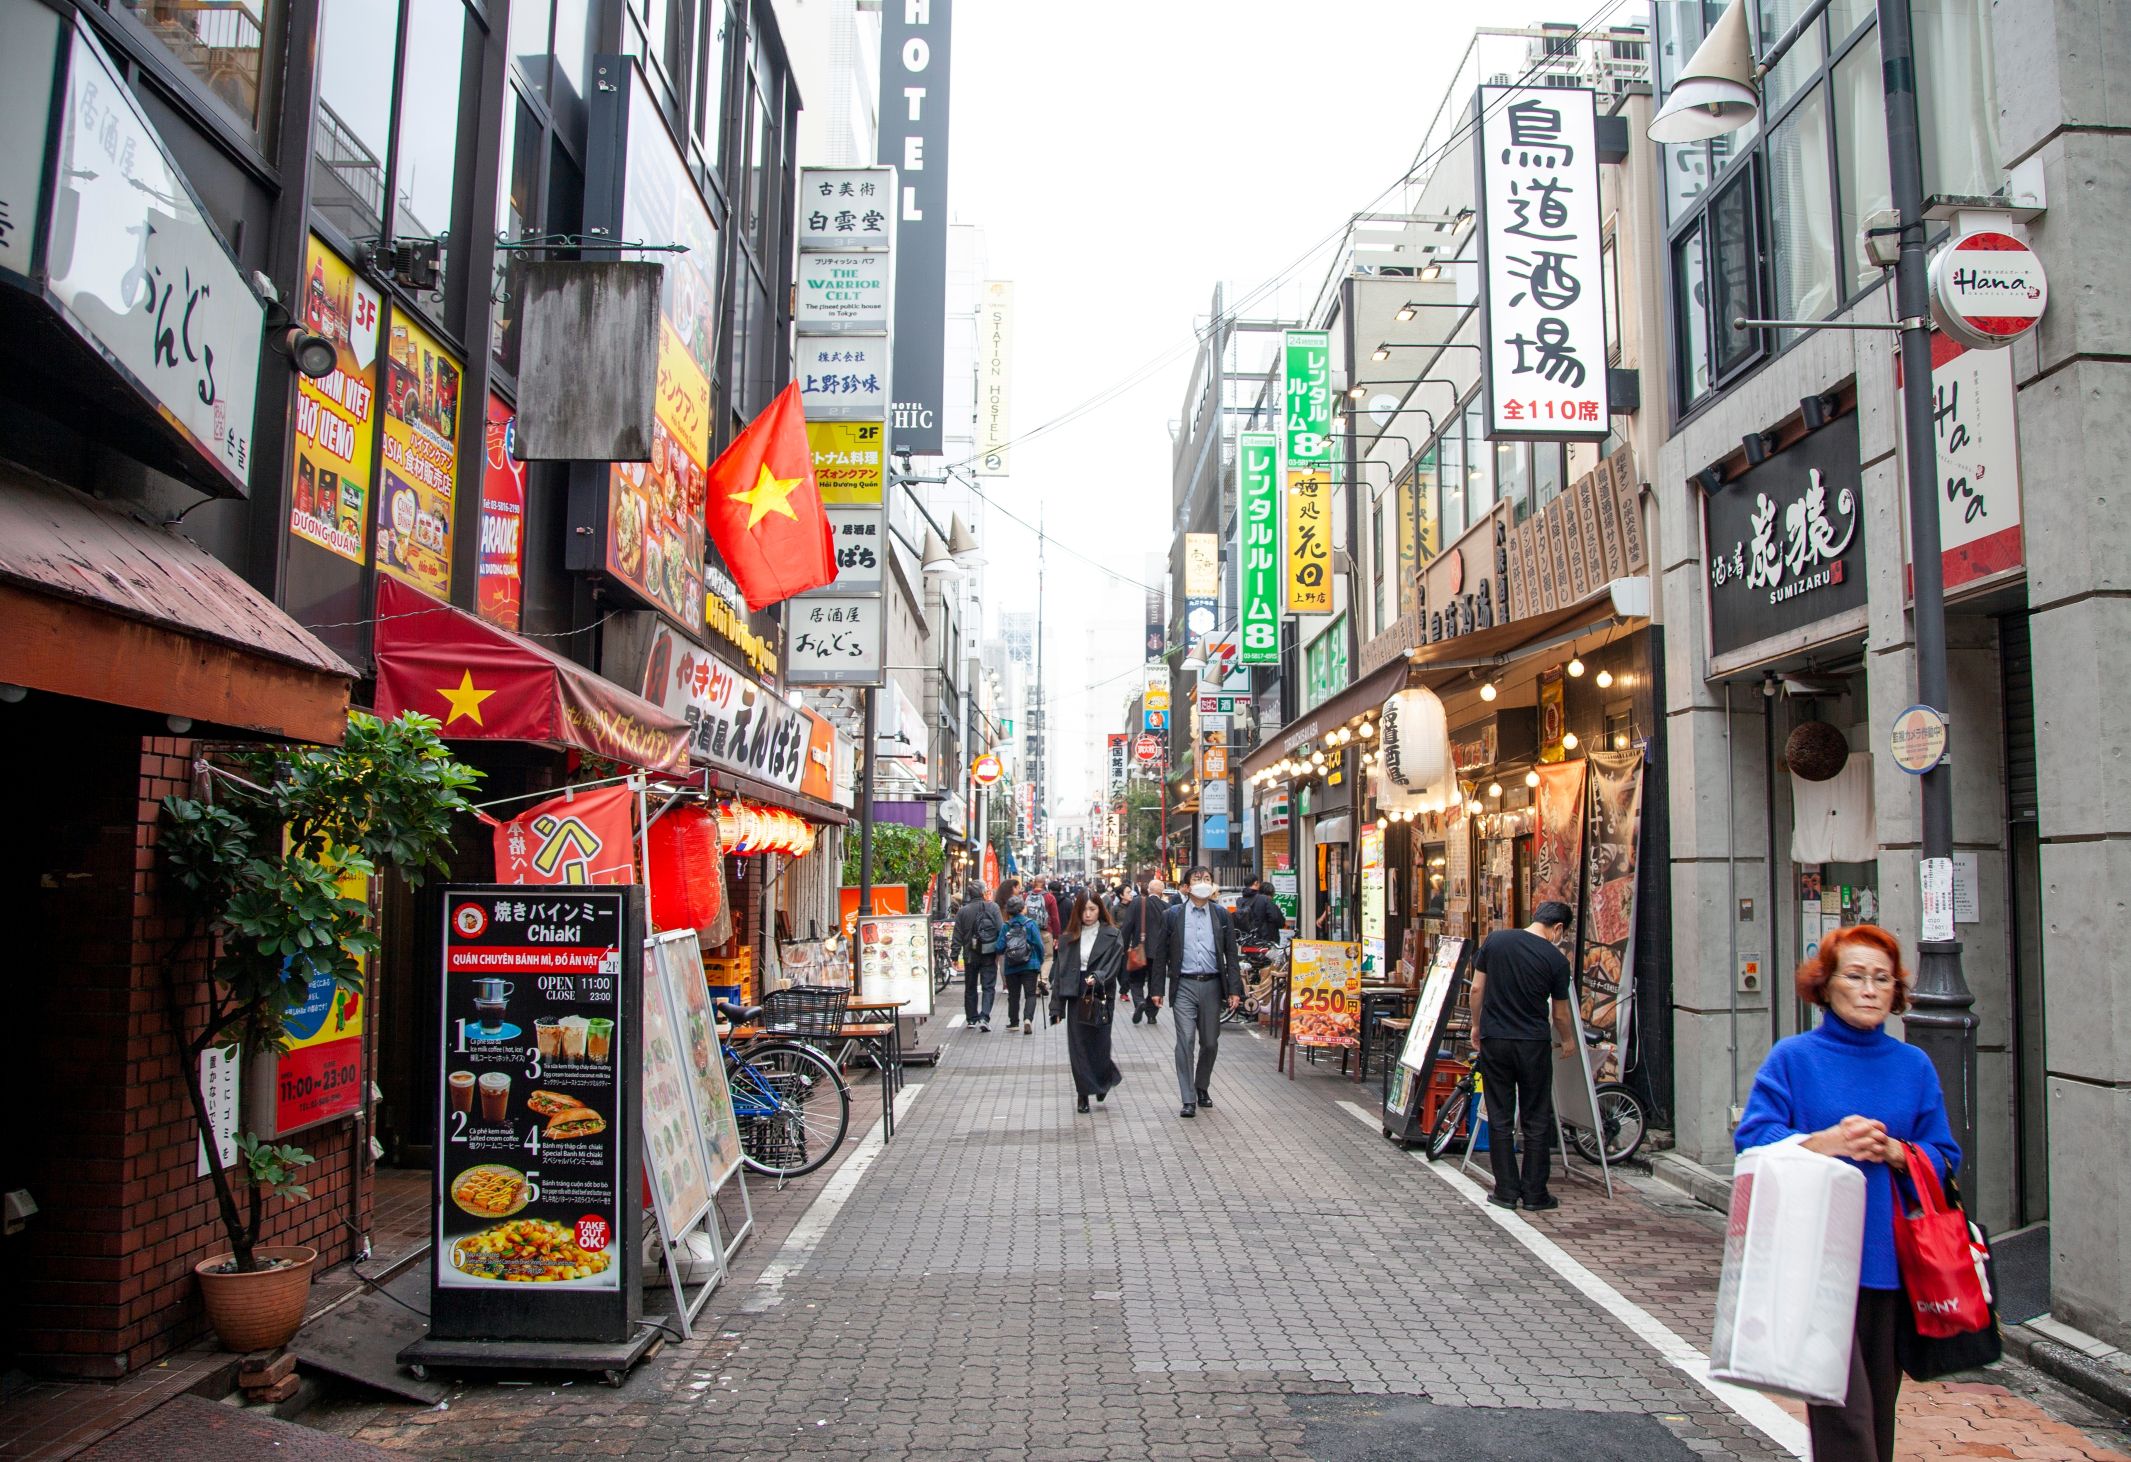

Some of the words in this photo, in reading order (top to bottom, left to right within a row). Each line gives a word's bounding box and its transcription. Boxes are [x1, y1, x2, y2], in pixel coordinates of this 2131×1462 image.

[902, 0, 930, 220] HOTEL
[819, 181, 876, 197] 古美術
[808, 209, 884, 233] 白雲堂
[1501, 99, 1586, 389] 鳥道酒場
[830, 268, 858, 278] THE
[1953, 268, 2027, 295] Hana
[807, 279, 880, 289] WARRIOR
[825, 291, 861, 301] CELT
[355, 292, 376, 333] 3F
[839, 304, 860, 312] public
[831, 322, 854, 330] 3F
[991, 312, 1001, 376] STATION
[818, 351, 865, 362] 株式会社
[801, 373, 880, 394] 上野珍味
[1308, 352, 1328, 422] レンタル
[345, 376, 371, 426] VIỆT
[1288, 378, 1308, 431] ルーム
[1503, 398, 1600, 423] 全110席
[891, 410, 933, 428] HIC
[990, 385, 1001, 441] HOSTEL
[318, 420, 355, 464] UENO
[858, 427, 879, 439] 2F
[1294, 432, 1323, 457] 8
[382, 432, 403, 466] ASIA
[404, 448, 454, 498] 食材販売店
[481, 514, 520, 555] ARAOKE
[842, 524, 877, 536] 居酒屋
[837, 545, 877, 568] ぱち
[1770, 569, 1830, 604] SUMIZARU
[1294, 592, 1326, 604] 上野店
[810, 607, 862, 623] 居酒屋
[676, 651, 734, 710] やきとり
[822, 672, 845, 680] 1F
[1220, 699, 1231, 711] 酒
[494, 900, 613, 922] 焼きバインミー
[527, 925, 581, 943] Chiaki
[453, 953, 478, 966] QUÁN
[479, 953, 516, 966] CHUYÊN
[516, 953, 540, 966] BÁNH
[606, 960, 619, 973] 2F
[538, 976, 574, 991] OPEN
[581, 978, 610, 990] 11:00
[546, 990, 576, 1001] CLOSE
[590, 992, 611, 1001] 23:00
[453, 1018, 470, 1053] 1
[525, 1047, 542, 1080] 3
[450, 1110, 468, 1142] 2
[488, 1127, 500, 1135] kem
[468, 1142, 521, 1150] 塩クリームコーヒー
[523, 1124, 541, 1156] 4
[524, 1171, 540, 1203] 5
[578, 1221, 605, 1231] TAKE
[581, 1229, 603, 1237] OUT
[449, 1236, 466, 1268] 6
[579, 1236, 605, 1249] OK!
[1917, 1296, 1960, 1315] DKNY
